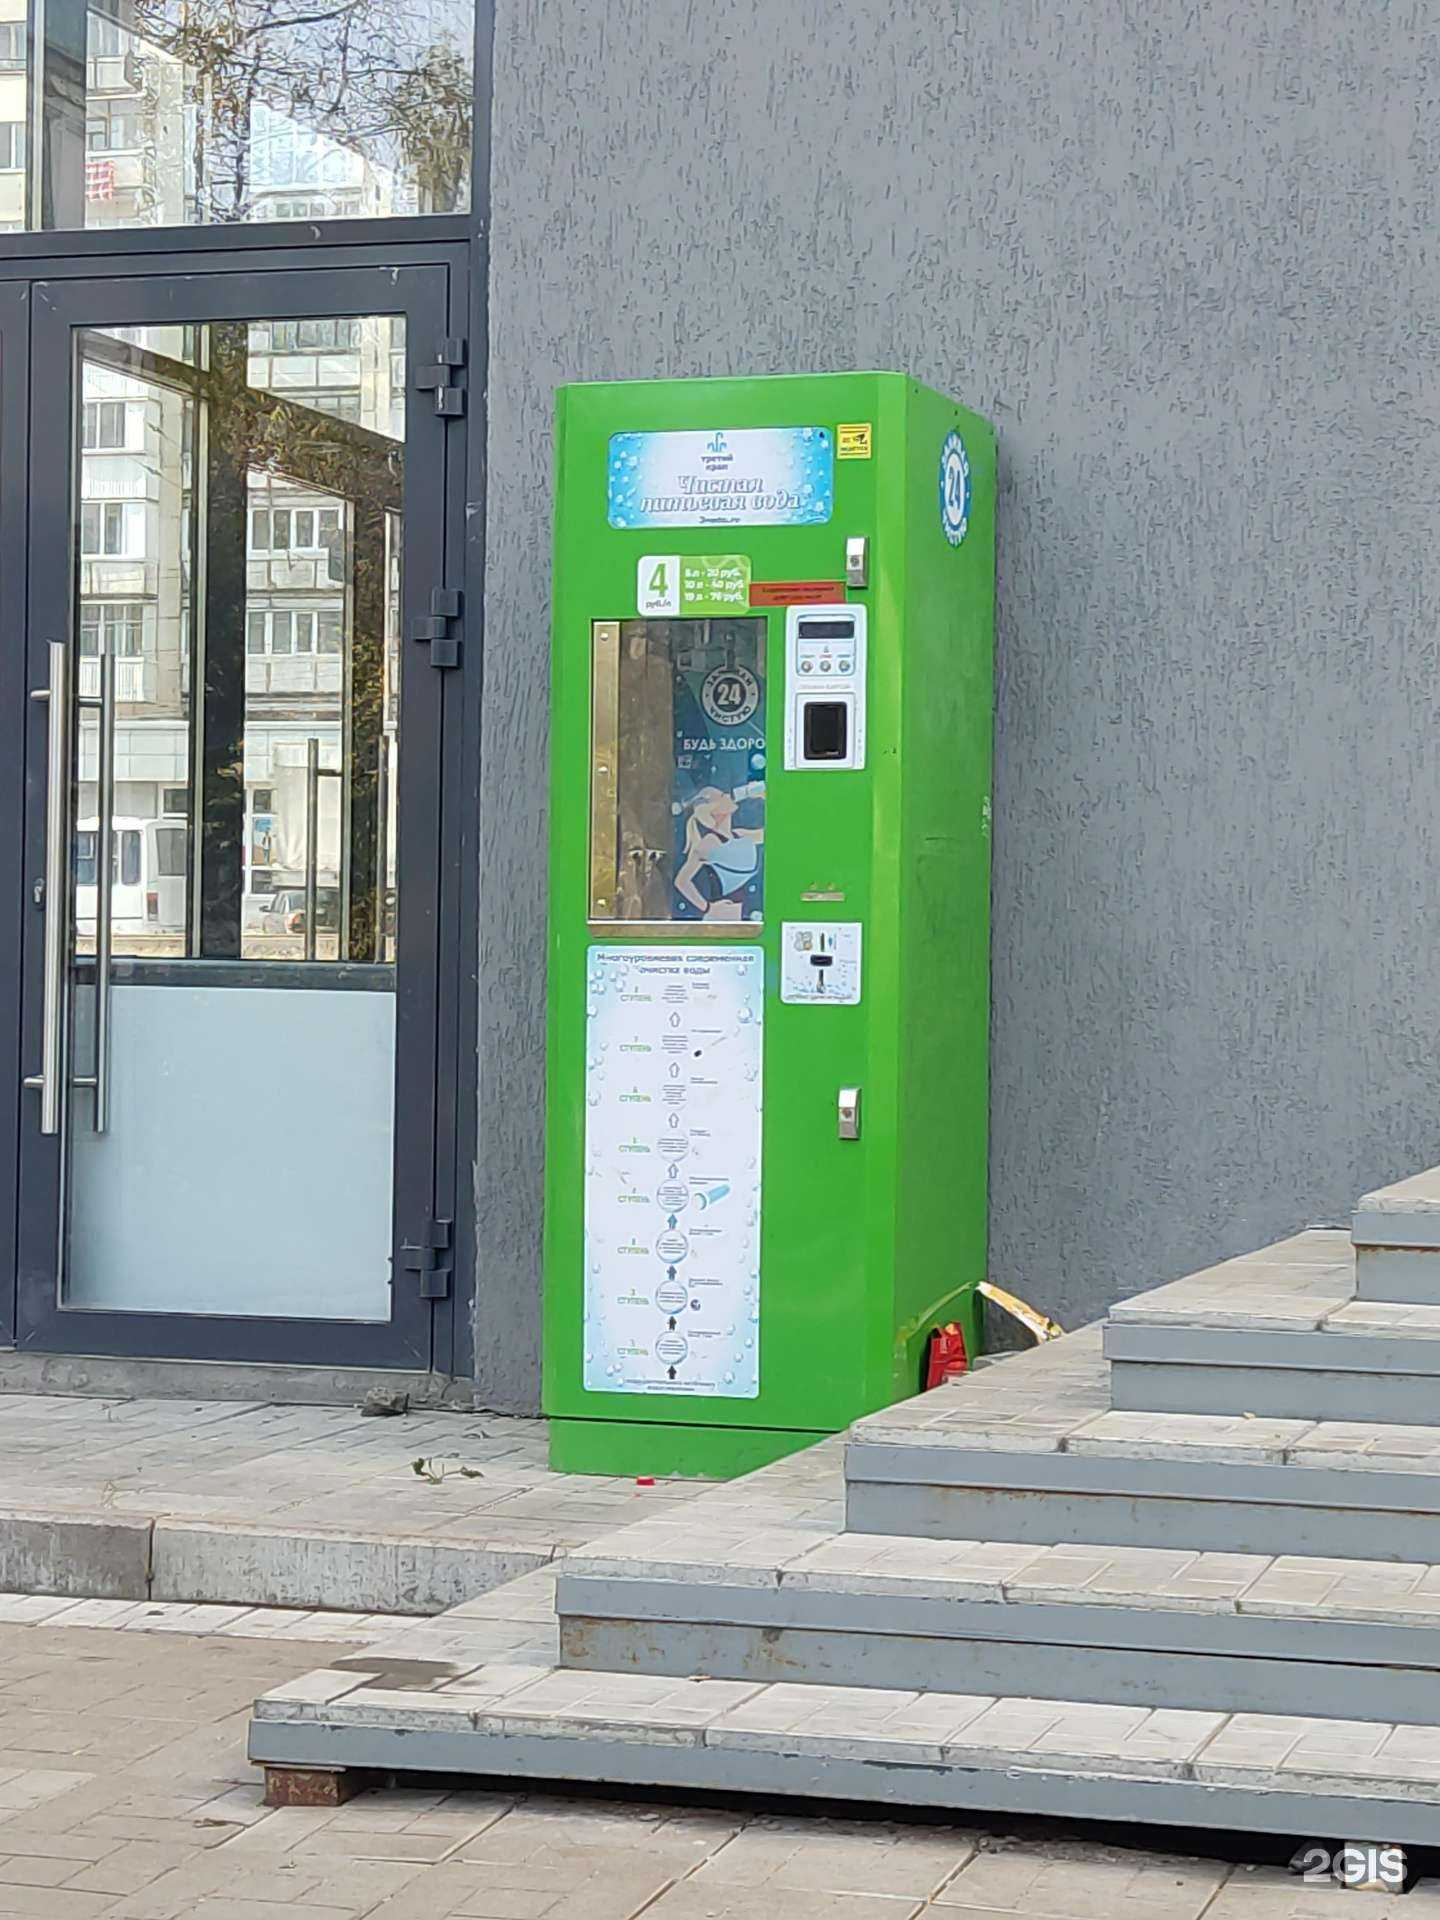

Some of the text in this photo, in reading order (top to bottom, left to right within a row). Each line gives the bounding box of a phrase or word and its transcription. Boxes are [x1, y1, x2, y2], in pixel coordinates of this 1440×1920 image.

[677, 475, 764, 495] Чистая
[639, 488, 802, 512] питьевая вода
[648, 562, 669, 598] 4
[684, 580, 695, 589] 10
[717, 682, 742, 706] 24
[683, 737, 766, 751] БУДЬ ЗДОРО
